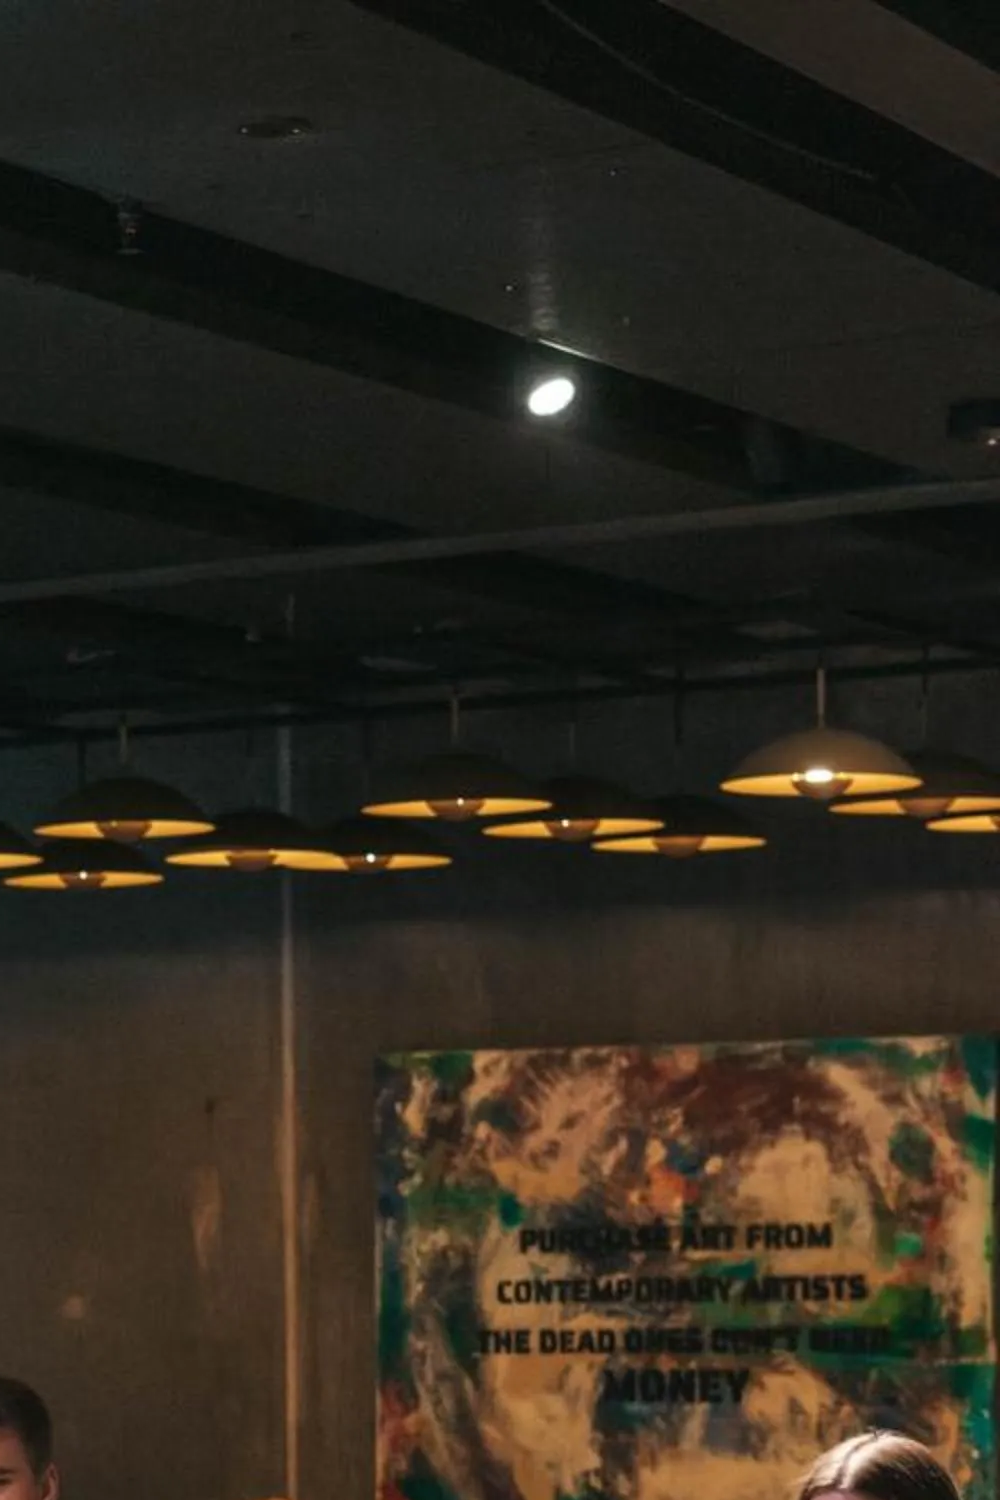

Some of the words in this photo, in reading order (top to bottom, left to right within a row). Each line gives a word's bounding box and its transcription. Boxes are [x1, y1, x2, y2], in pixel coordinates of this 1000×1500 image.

[518, 1223, 671, 1255] PURCHASE
[679, 1222, 735, 1252] ART
[745, 1222, 833, 1250] FROM
[496, 1276, 735, 1304] CONTEMPORARY
[740, 1273, 868, 1303] ARTISTS
[478, 1327, 531, 1355] THE
[538, 1327, 614, 1355] DEAD
[624, 1327, 703, 1355] ONES
[604, 1369, 750, 1402] MONEY
